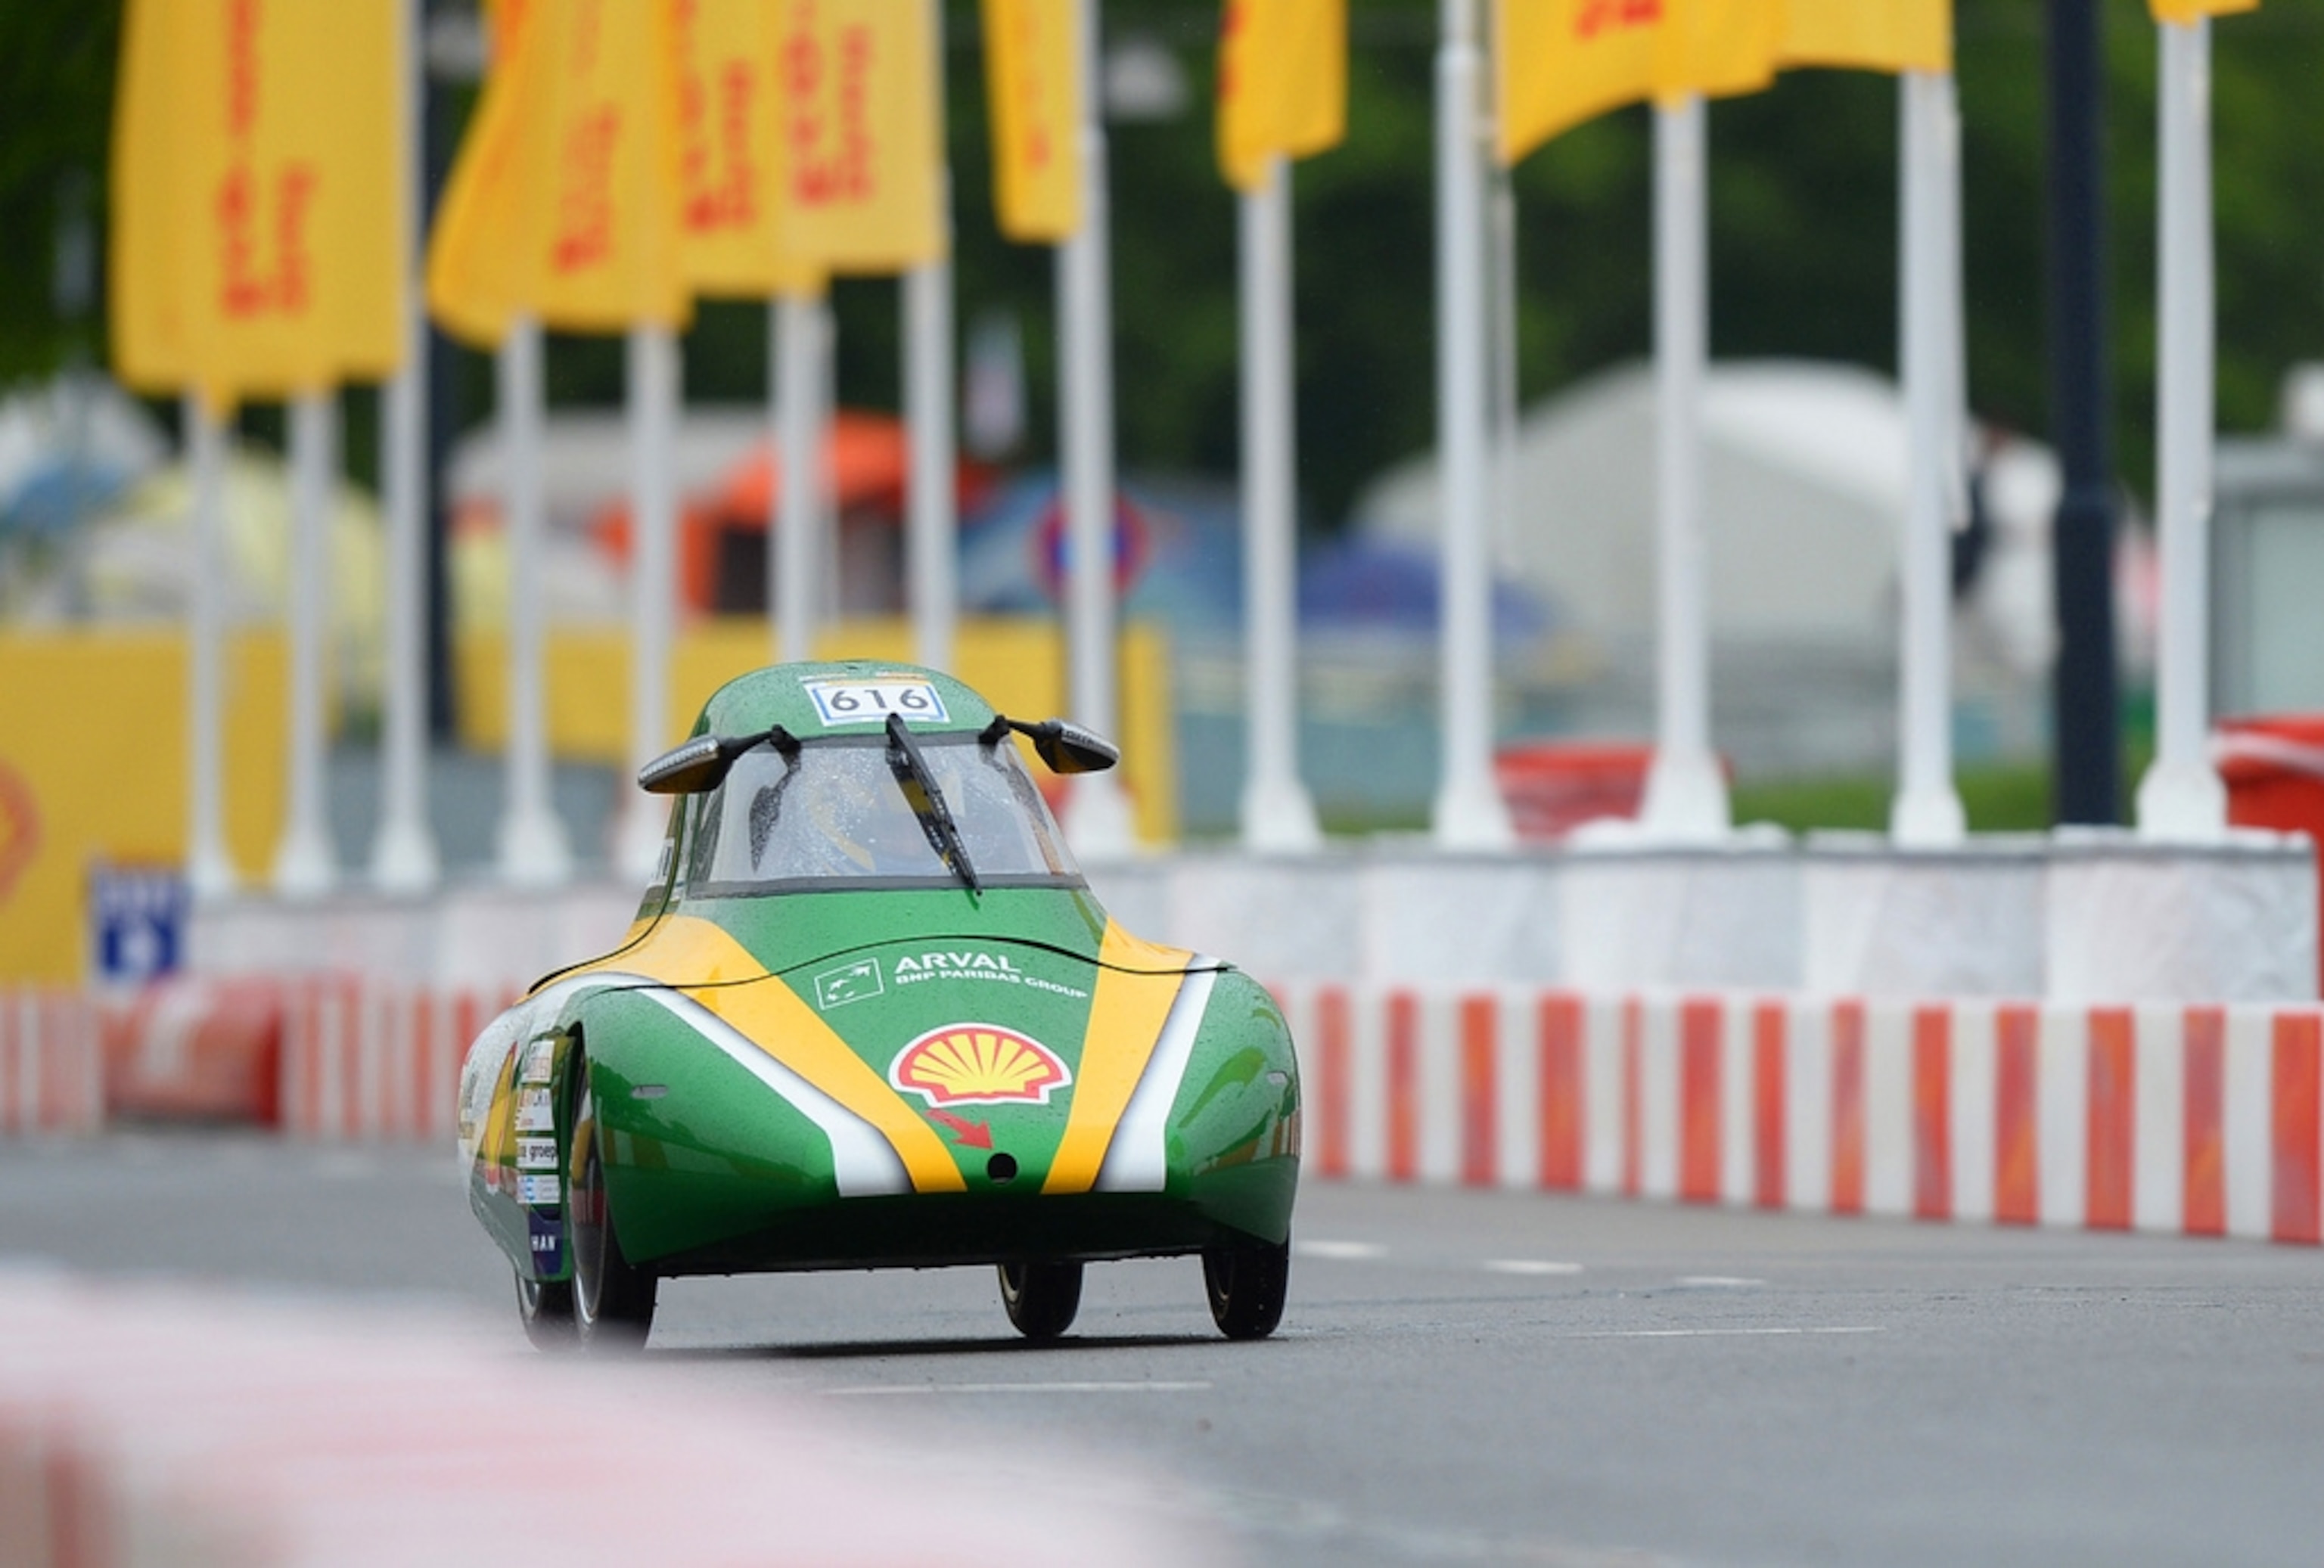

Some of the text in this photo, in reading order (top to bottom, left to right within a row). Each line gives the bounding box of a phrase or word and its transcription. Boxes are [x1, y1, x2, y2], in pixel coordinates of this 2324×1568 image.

[831, 688, 928, 711] 616
[894, 952, 1021, 974] ARVAL
[895, 969, 1088, 998] BNP PARIBAS GROUP
[530, 1144, 556, 1163] groep
[532, 1234, 555, 1252] HAN
